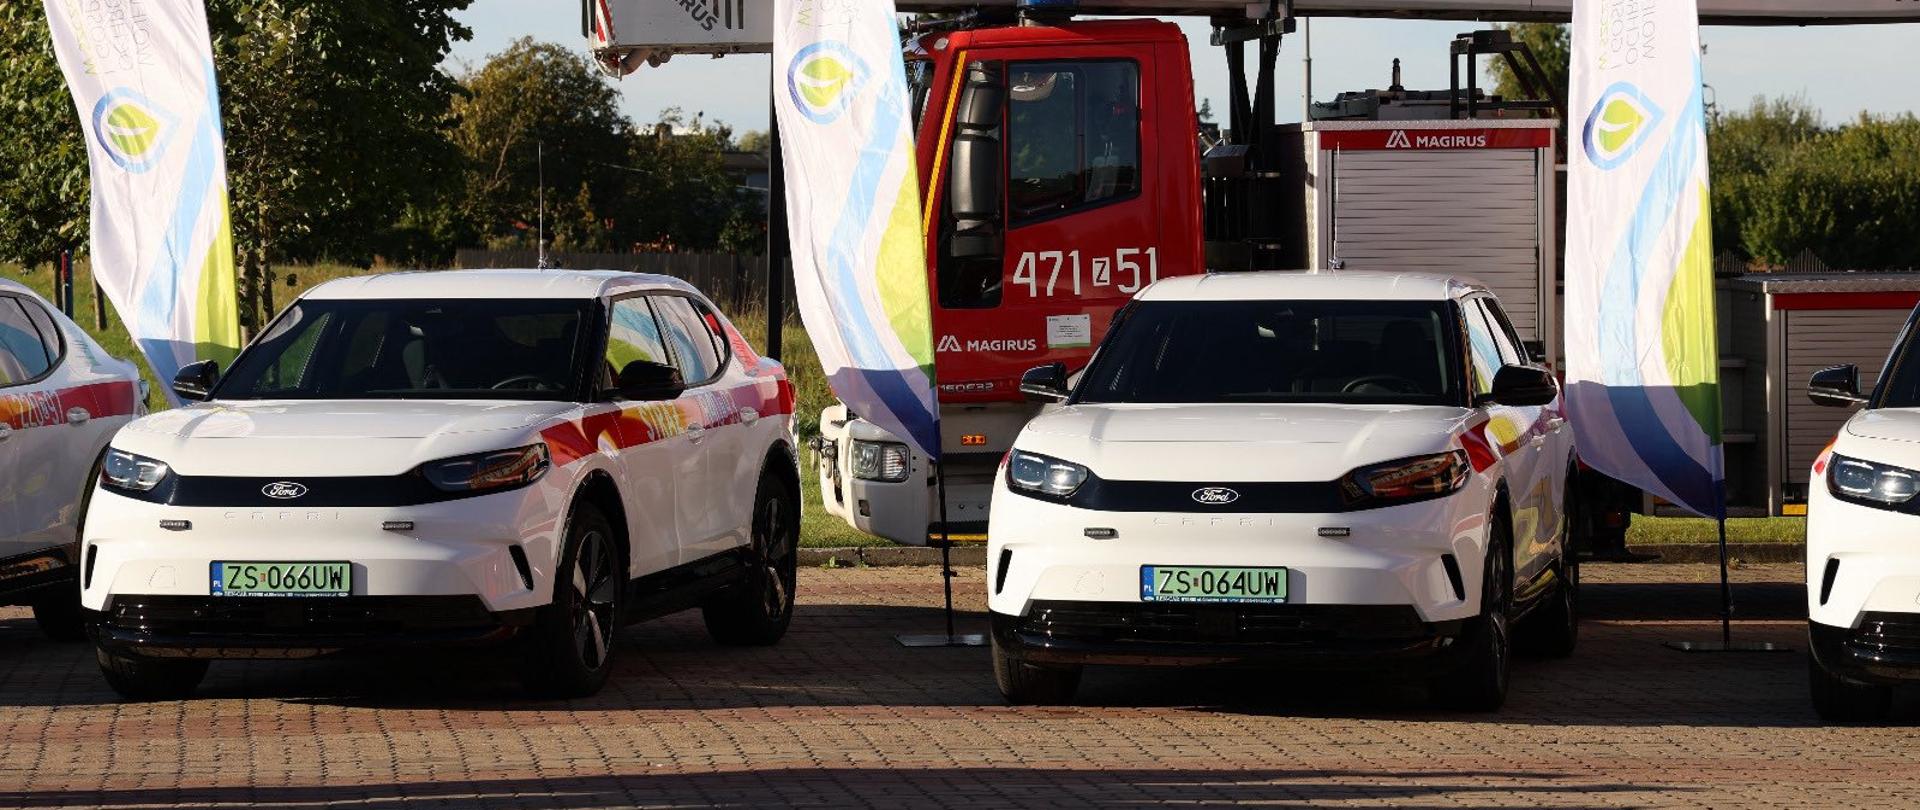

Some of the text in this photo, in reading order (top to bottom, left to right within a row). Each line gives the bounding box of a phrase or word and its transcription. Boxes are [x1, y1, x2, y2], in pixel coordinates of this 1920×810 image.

[674, 0, 718, 31] RUS
[1416, 135, 1486, 148] MAGIRUS
[1012, 250, 1081, 297] 471
[1116, 247, 1157, 293] 51
[967, 339, 1037, 351] MAGIRUS
[269, 483, 298, 497] Ford
[1200, 488, 1229, 502] Ford
[213, 565, 344, 590] PL ZS 066UW
[1144, 570, 1280, 595] PL ZS 064UW
